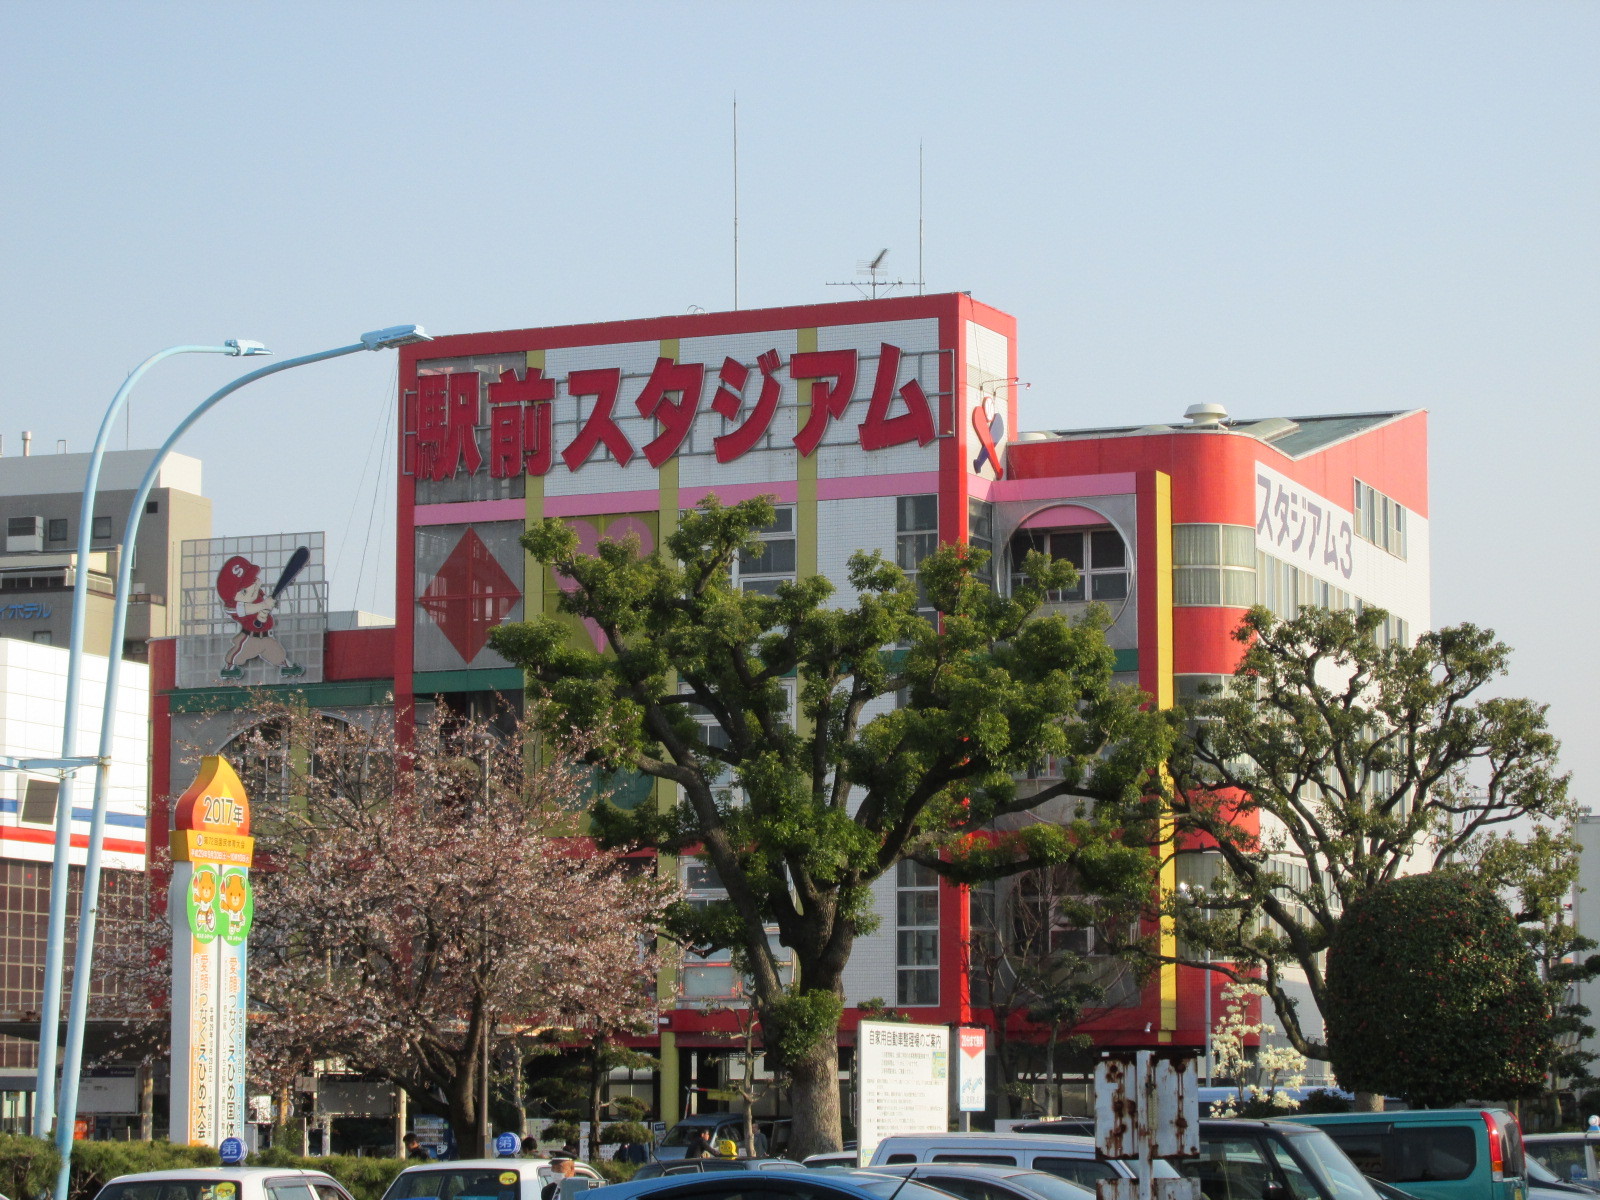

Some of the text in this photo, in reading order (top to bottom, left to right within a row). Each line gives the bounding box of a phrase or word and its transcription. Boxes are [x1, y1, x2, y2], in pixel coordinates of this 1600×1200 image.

[414, 342, 936, 481] 駅前スタジアム
[1256, 474, 1354, 580] スタジアム3
[232, 564, 244, 578] S
[203, 796, 244, 827] 2017年
[197, 954, 209, 1139] 愛顔つなぐえひめ大会
[869, 1030, 942, 1049] 自家用自動車整理場のご案内
